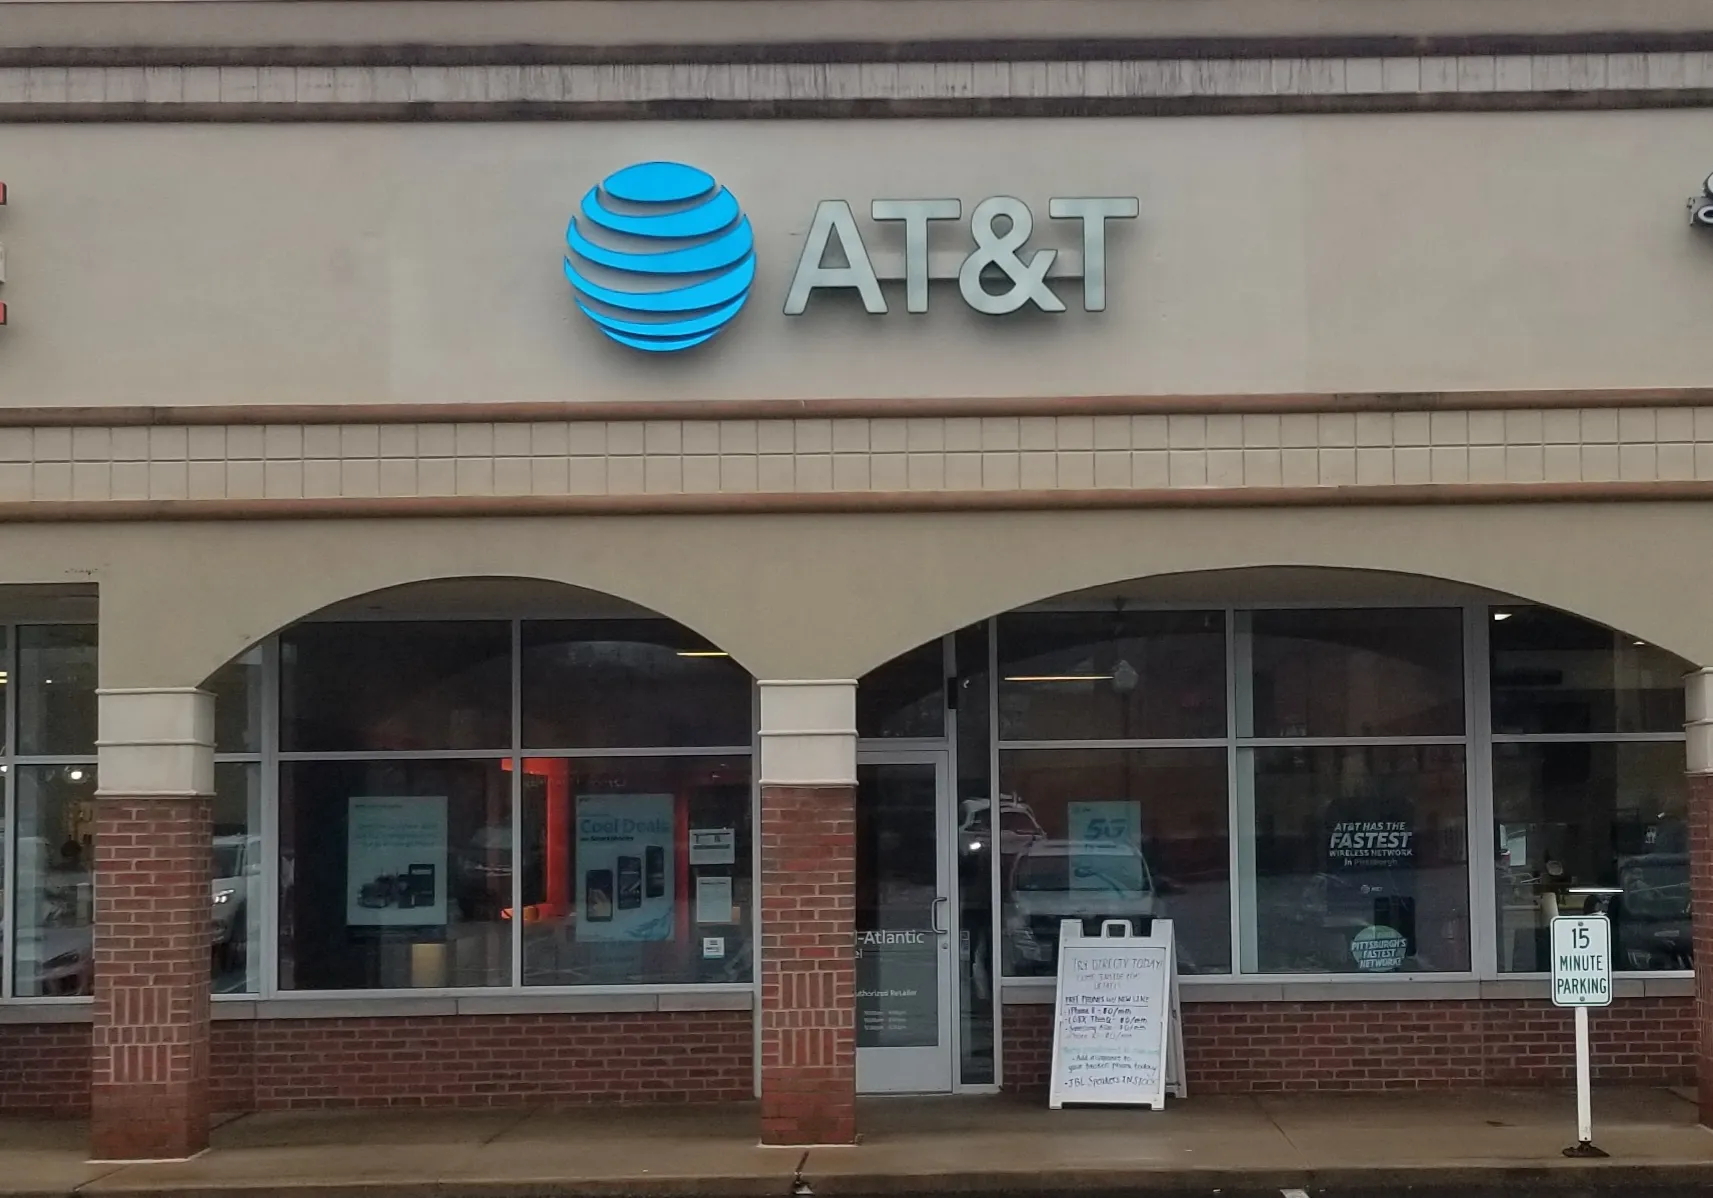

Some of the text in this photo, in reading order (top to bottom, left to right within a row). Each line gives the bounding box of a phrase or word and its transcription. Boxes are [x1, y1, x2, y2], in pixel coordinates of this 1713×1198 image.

[783, 195, 1139, 315] AT&T
[580, 819, 619, 834] Cool
[1362, 822, 1384, 831] HAS
[1387, 822, 1406, 830] THE
[1330, 832, 1412, 849] FASTEST
[1329, 849, 1413, 857] WIRELESS NETWORK
[1351, 938, 1408, 950] PITTSBURGH'S
[1572, 928, 1590, 949] 15
[1363, 950, 1397, 959] FASTEST
[1560, 955, 1604, 971] MINUTE
[1557, 978, 1607, 994] PARKING
